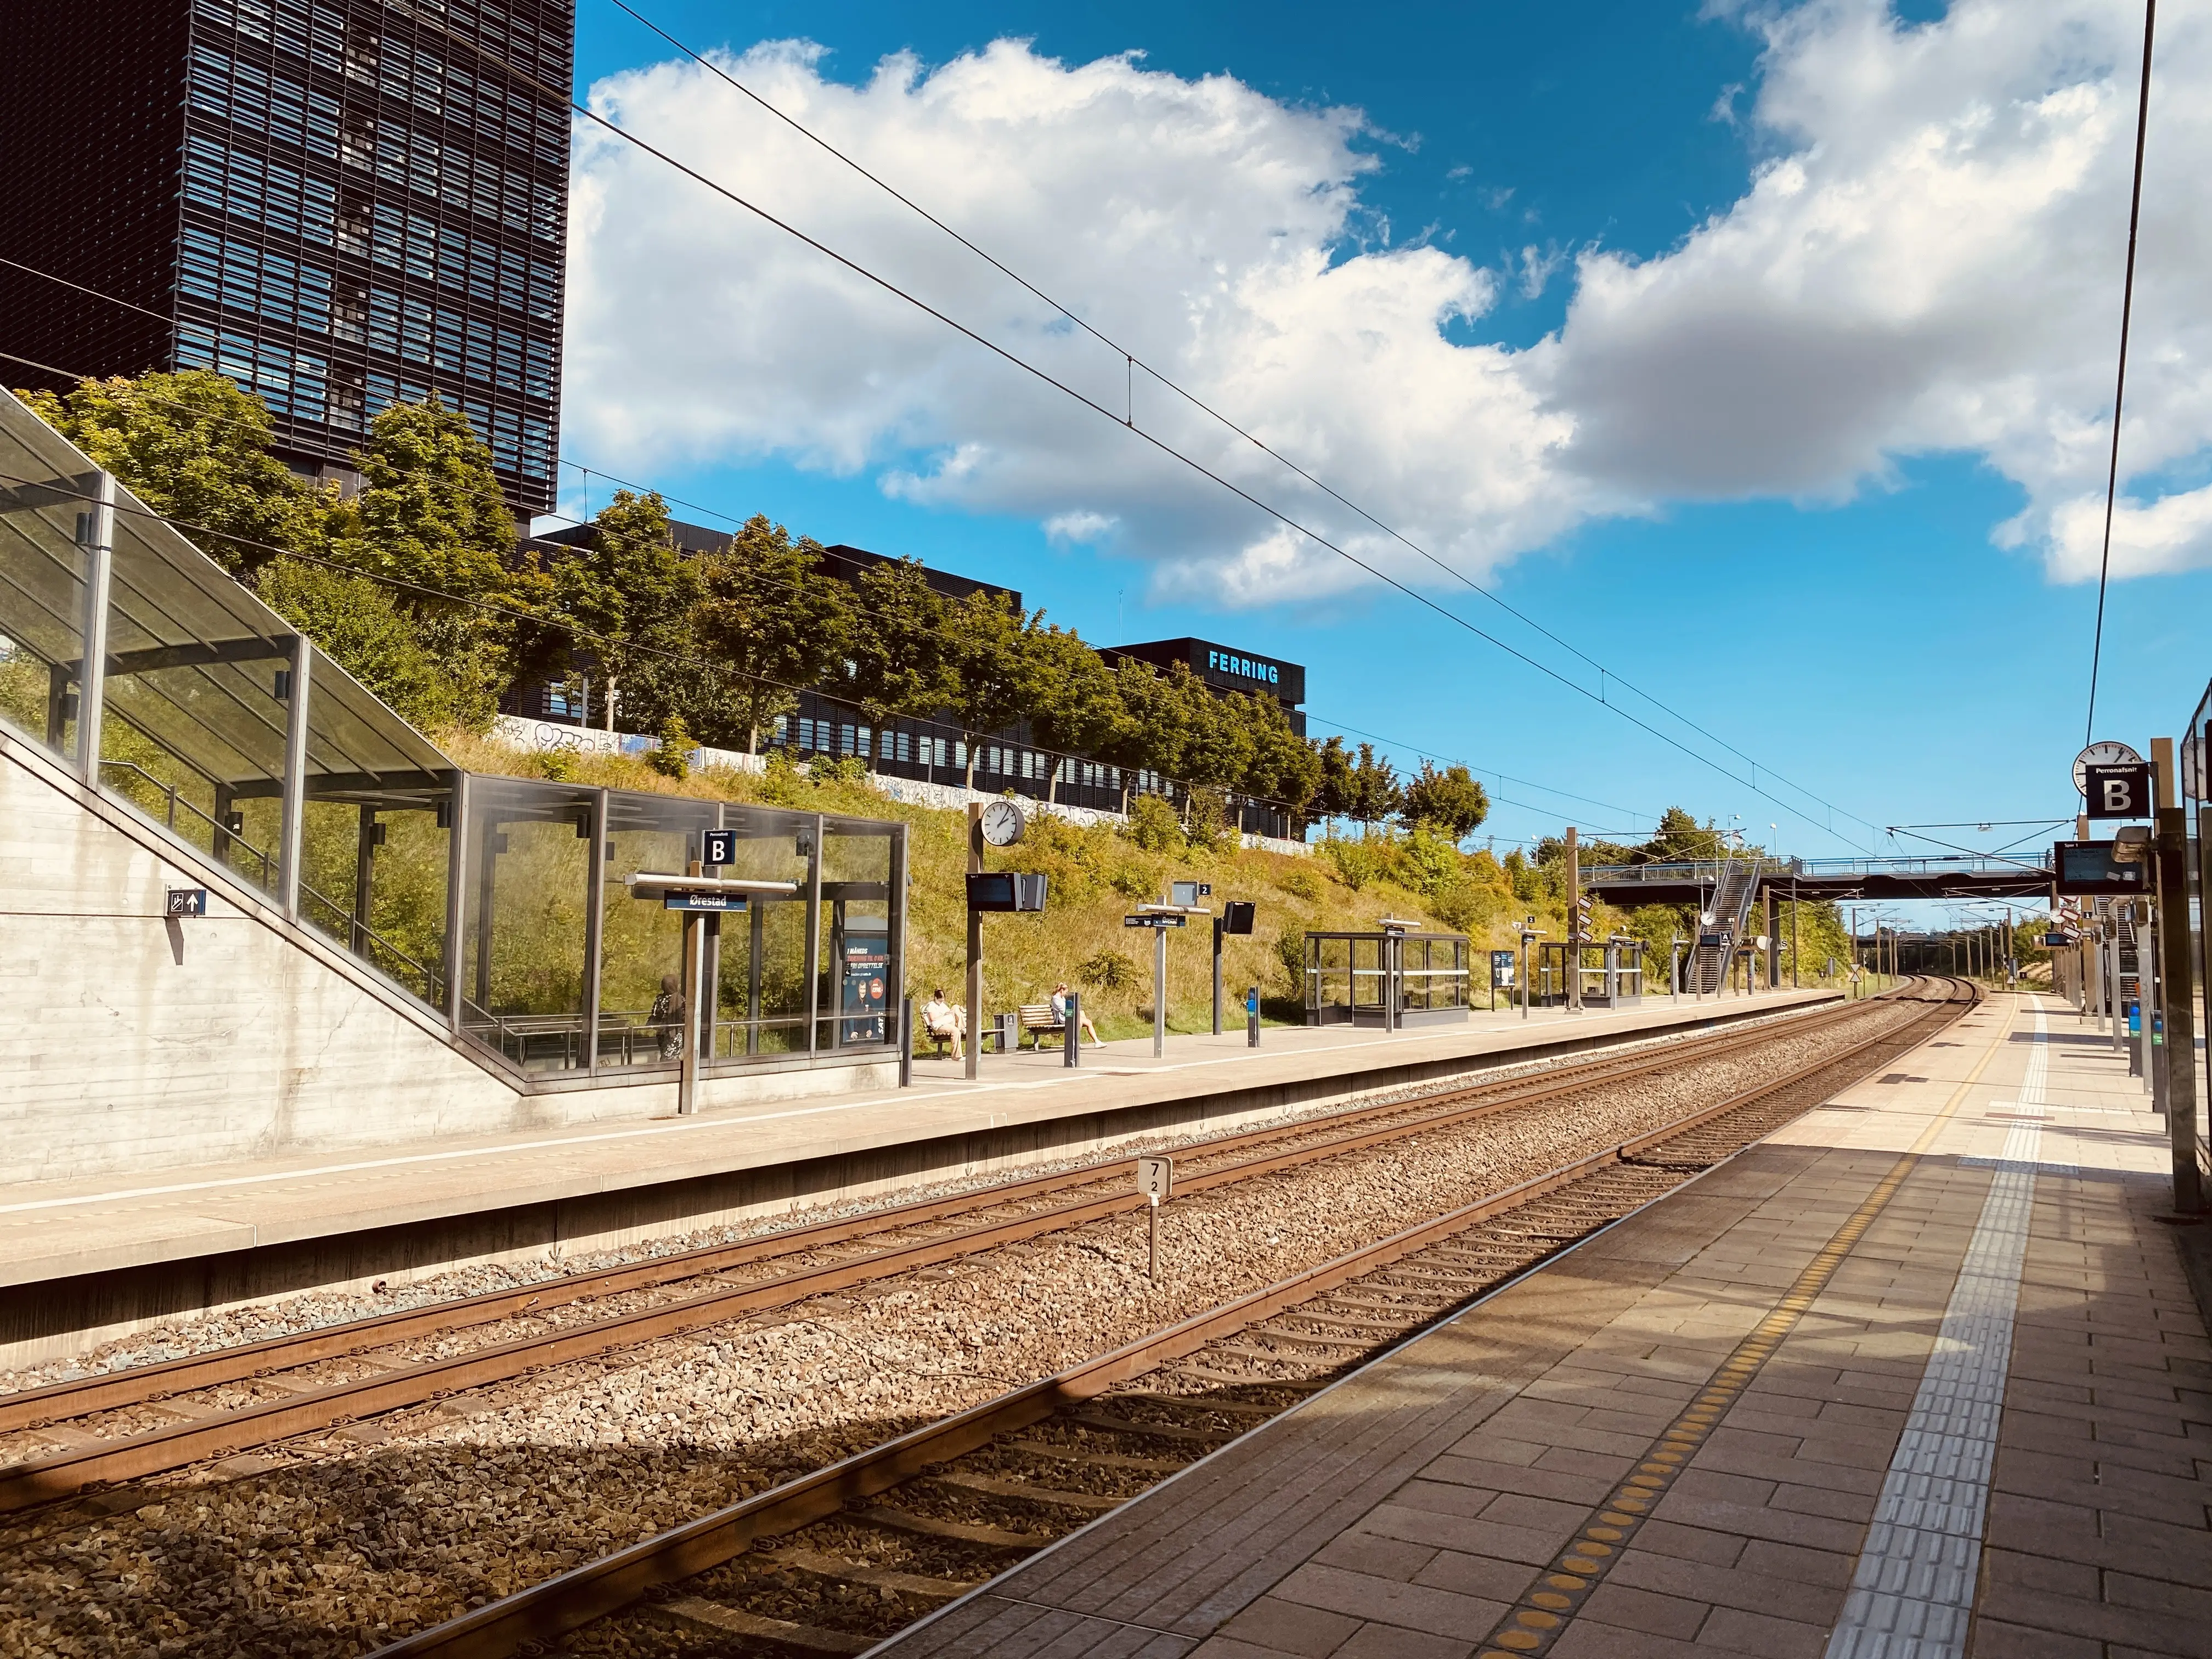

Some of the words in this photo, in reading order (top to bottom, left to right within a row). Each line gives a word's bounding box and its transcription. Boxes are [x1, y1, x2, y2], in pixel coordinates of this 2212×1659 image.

[1209, 651, 1278, 684] FERRING
[2103, 780, 2131, 811] B
[712, 840, 725, 861] B
[690, 894, 727, 906] Ørestad
[849, 946, 868, 955] MÅNEDS
[1151, 1163, 1159, 1176] 7
[1151, 1181, 1158, 1192] 2
